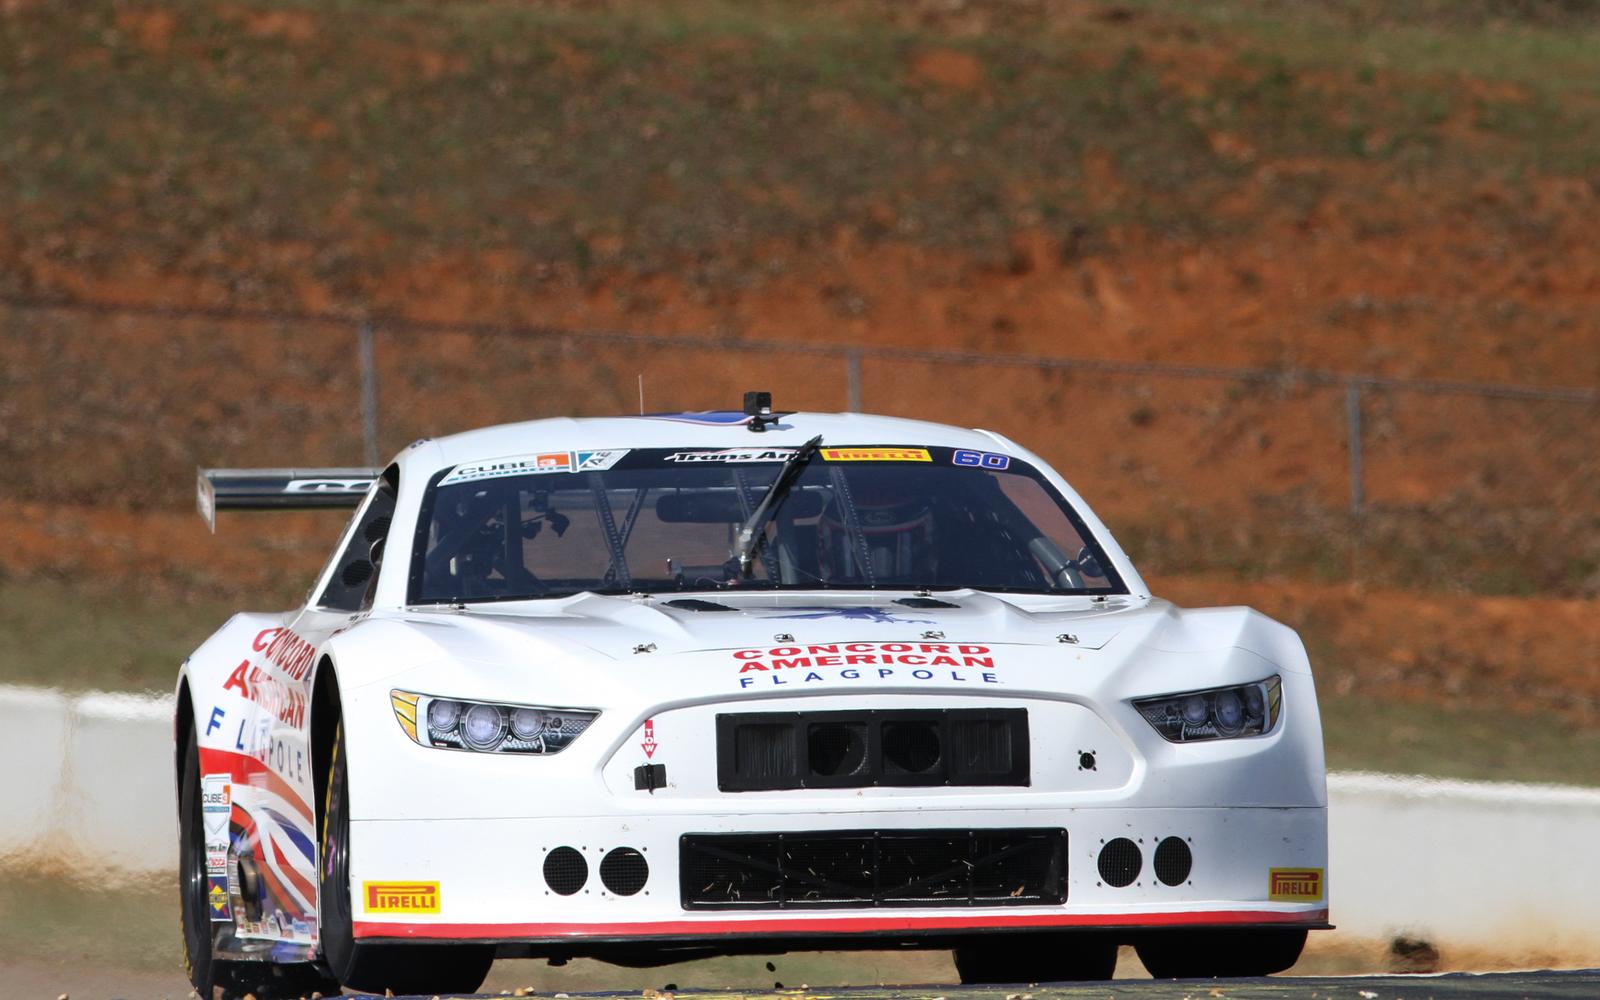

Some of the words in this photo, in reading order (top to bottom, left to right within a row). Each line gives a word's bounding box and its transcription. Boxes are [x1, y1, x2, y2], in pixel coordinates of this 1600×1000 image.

[674, 452, 752, 461] Trans
[827, 449, 925, 460] PIRELLI
[952, 449, 1010, 471] 60
[252, 627, 317, 681] CONCORD
[733, 644, 991, 660] CONCORD
[738, 654, 995, 674] AMERICAN
[739, 668, 998, 689] FLAGPOLE
[645, 728, 655, 753] TOW
[1271, 871, 1319, 896] PIRELLI
[367, 884, 436, 909] PIRELLI
